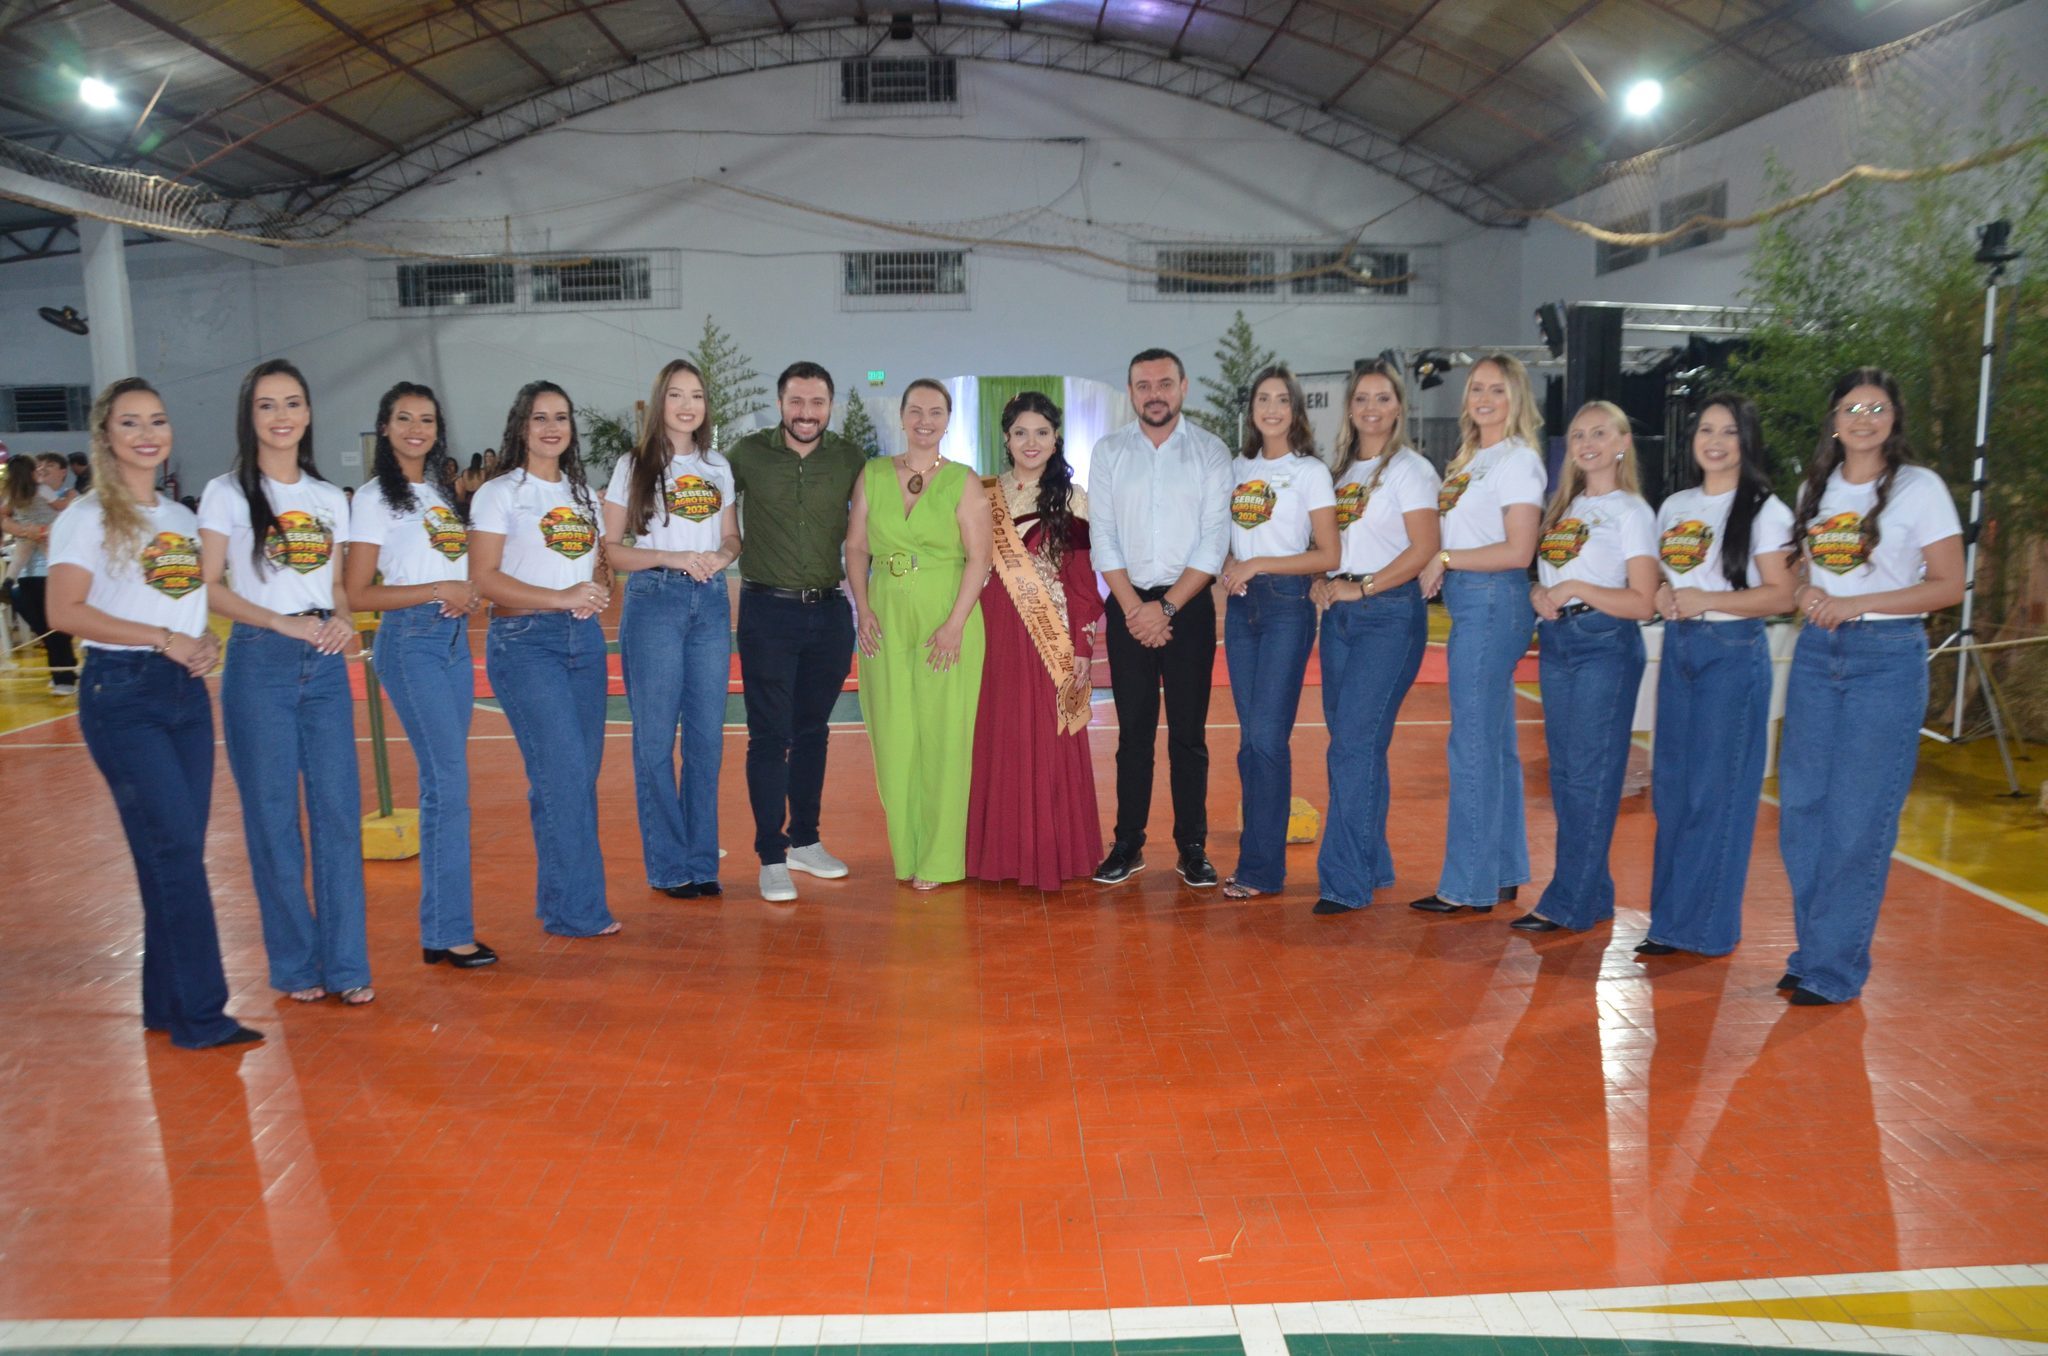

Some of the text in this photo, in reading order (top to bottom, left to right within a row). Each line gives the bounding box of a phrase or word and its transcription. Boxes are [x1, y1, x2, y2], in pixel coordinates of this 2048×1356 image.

[1307, 392, 1329, 409] ERI
[675, 490, 714, 498] SEBERI
[675, 497, 698, 506] AGRO
[1234, 495, 1265, 506] SEBERI
[685, 505, 709, 514] 2026
[1232, 503, 1265, 512] AGRO FEST
[1238, 511, 1257, 520] 2026
[552, 525, 589, 533] SEBERI
[1816, 532, 1859, 544] SEBERI
[561, 542, 583, 550] 2026
[1824, 554, 1853, 565] 2026
[1027, 604, 1060, 641] Grande
